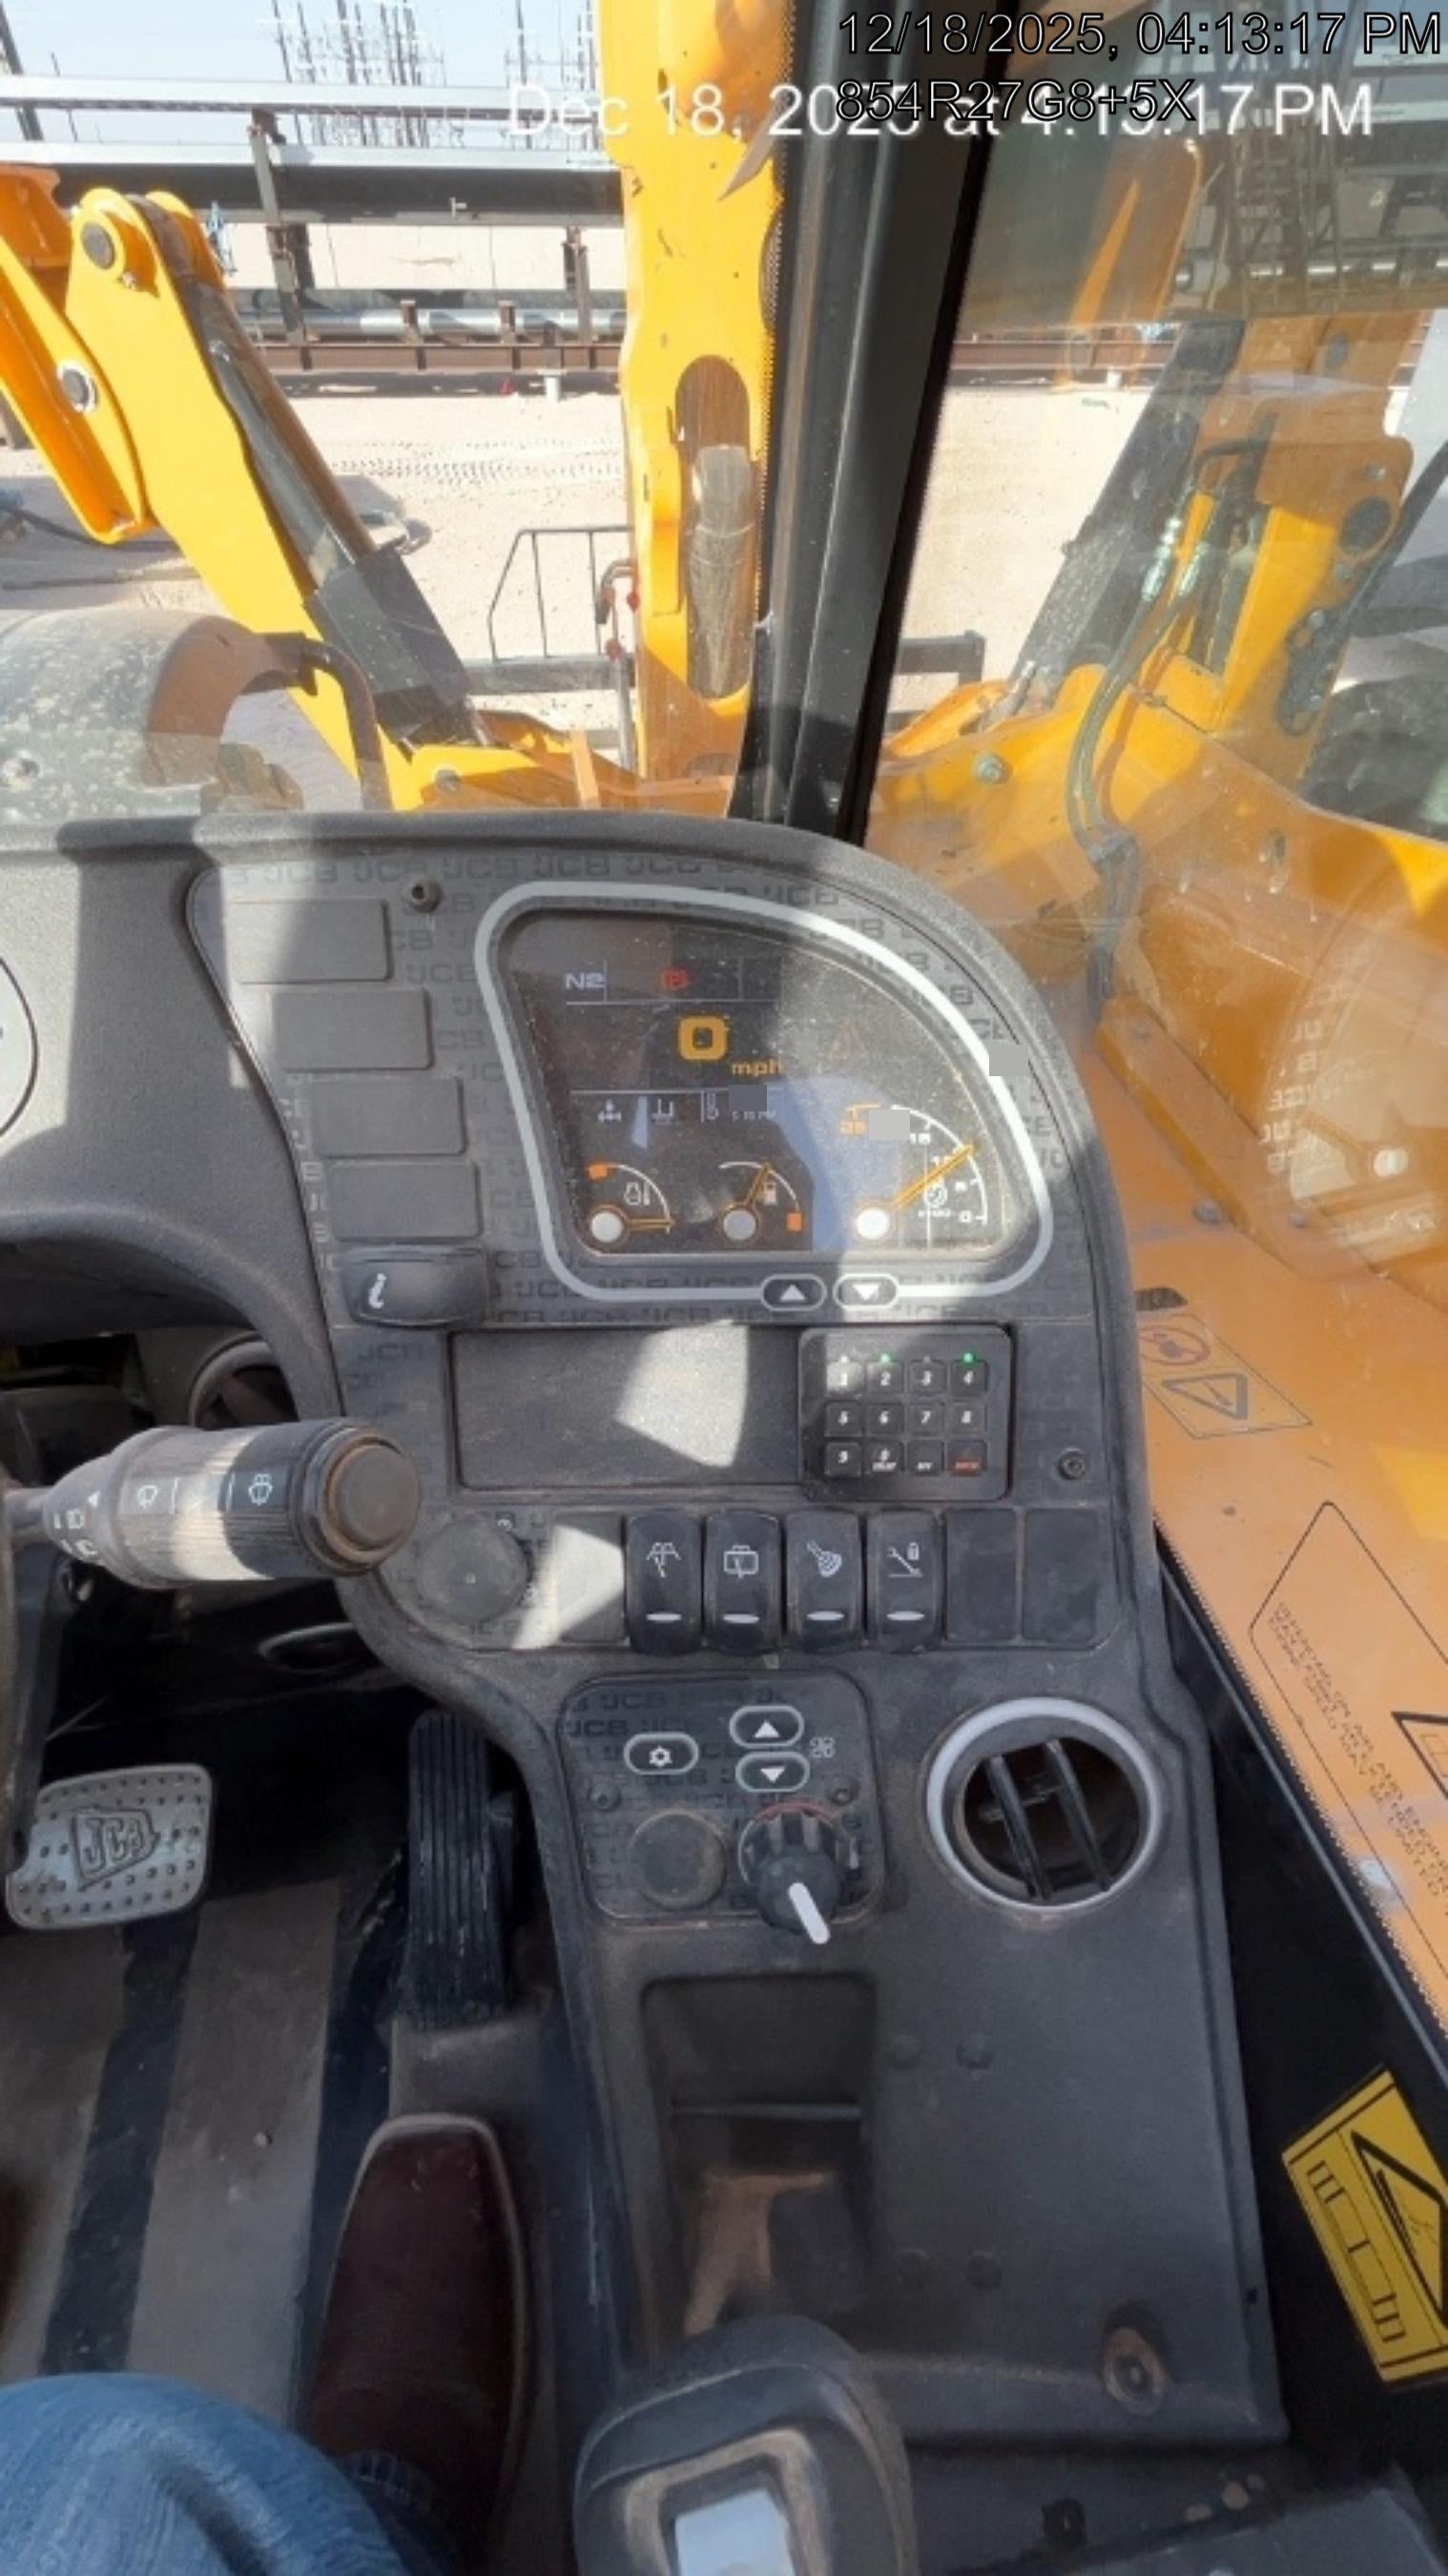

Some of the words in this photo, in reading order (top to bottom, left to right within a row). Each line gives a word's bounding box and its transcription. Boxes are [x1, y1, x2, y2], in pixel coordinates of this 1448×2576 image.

[534, 855, 610, 878] JCB
[678, 1015, 728, 1060] 0
[732, 1058, 784, 1078] mph
[879, 1370, 892, 1386] 2
[963, 1370, 974, 1385] 4
[879, 1410, 890, 1424] 6
[921, 1410, 932, 1424] 7
[961, 1410, 972, 1424] 8
[838, 1449, 849, 1465] 9
[83, 1816, 146, 1874] JCB
